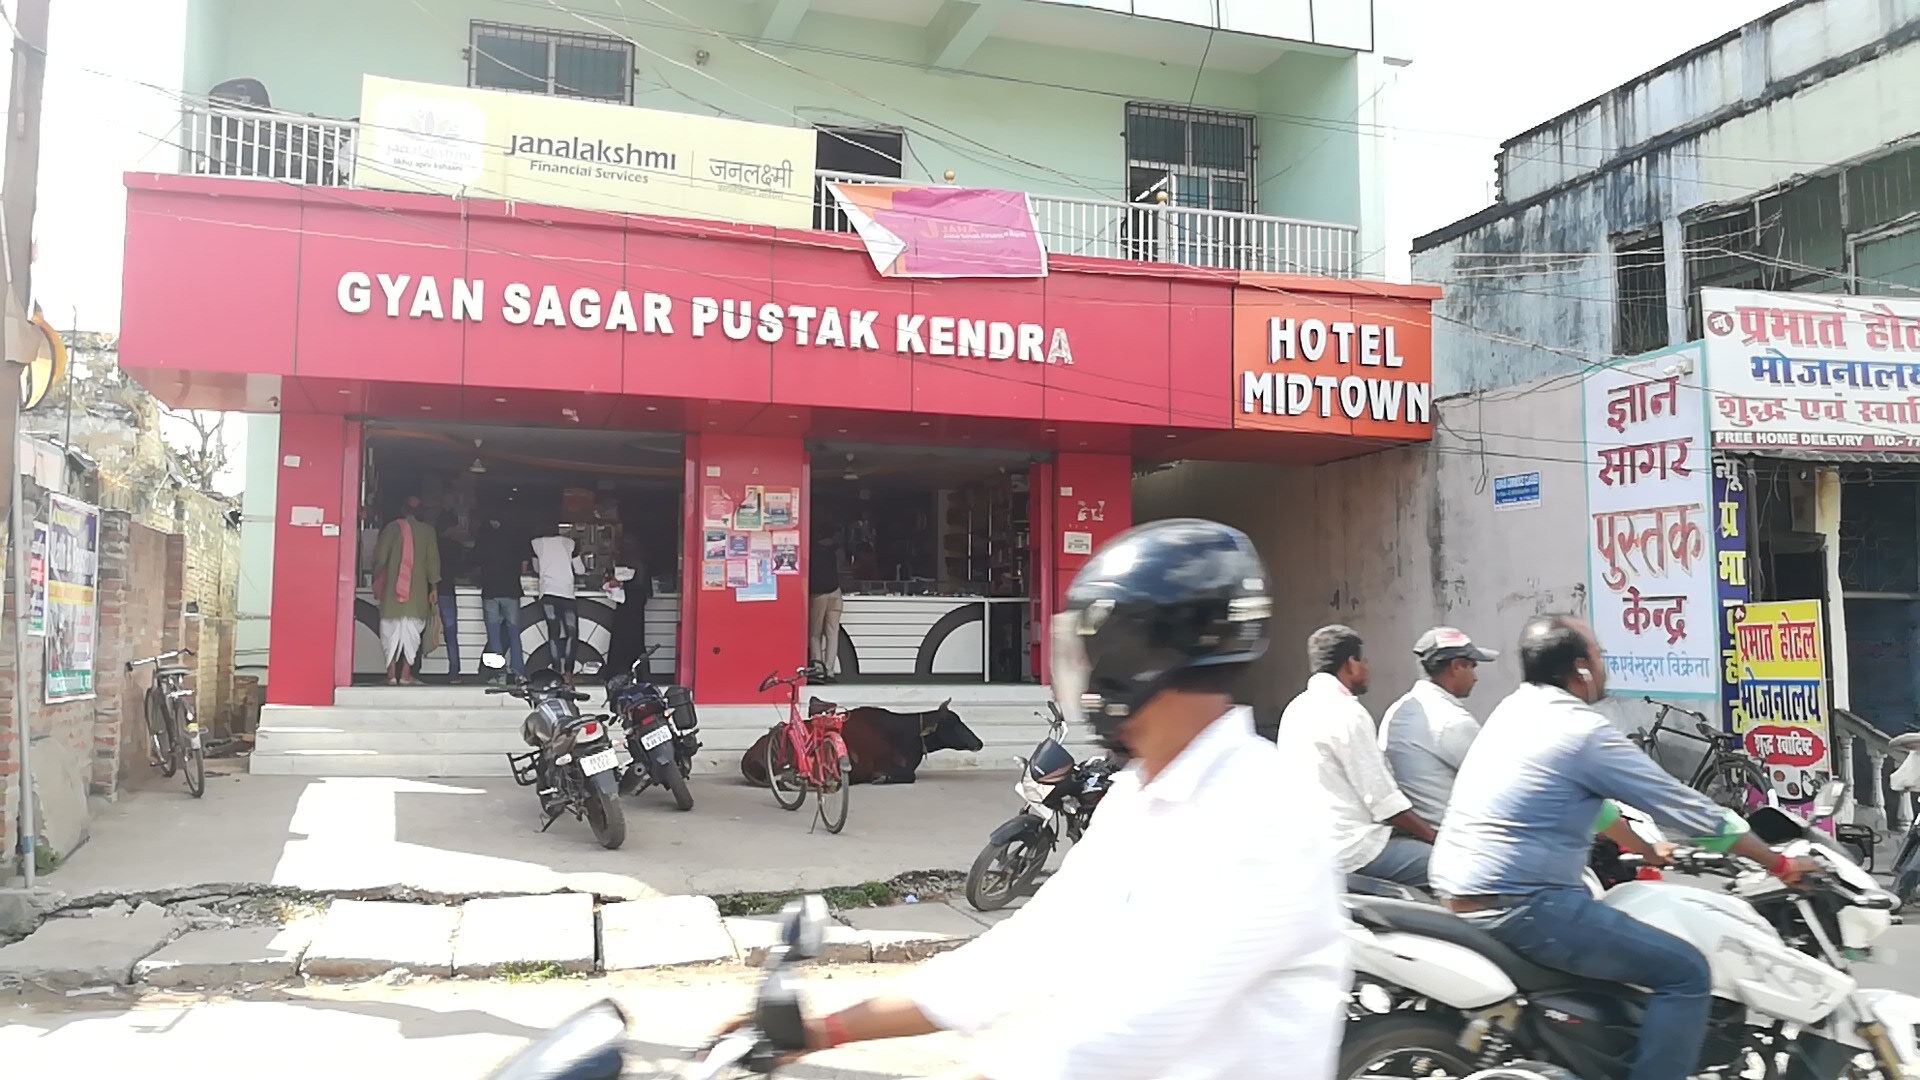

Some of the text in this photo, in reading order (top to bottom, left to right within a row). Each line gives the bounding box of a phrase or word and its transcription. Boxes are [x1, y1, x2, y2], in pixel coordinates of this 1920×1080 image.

[503, 135, 676, 170] janalakshmi
[530, 160, 649, 184] Financial Services
[709, 159, 794, 188] जनलक्ष्मी
[337, 272, 1074, 365] GYAN SAGAR PUSTAK KENDRA
[1270, 316, 1404, 367] HOTEL
[1735, 306, 1847, 347] प्रभात
[1243, 370, 1430, 424] MIDTOWN
[1608, 375, 1680, 433] ज्ञान
[1715, 396, 1787, 427] शुद्ध
[1795, 392, 1848, 422] एवं
[1598, 437, 1693, 486] सागर
[1716, 431, 1753, 444] FREE
[1757, 432, 1798, 445] HOME
[1801, 433, 1864, 446] DELEVRY
[1592, 503, 1703, 590] पुस्तक
[1622, 586, 1687, 645] केन्द्र
[1738, 612, 1817, 662] प्रभात होटल
